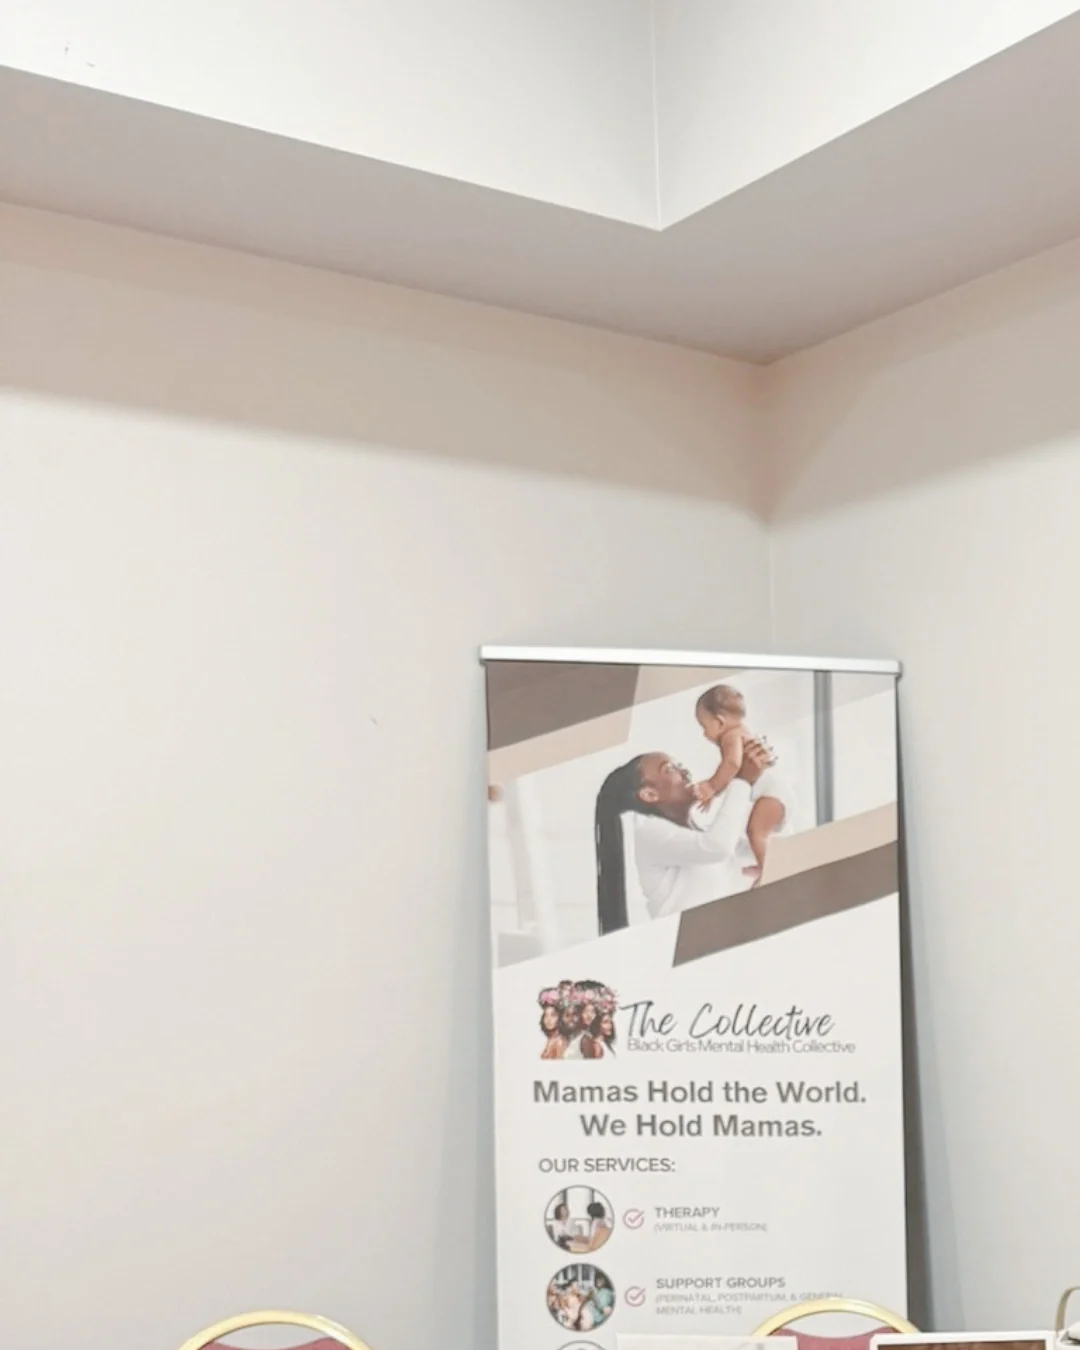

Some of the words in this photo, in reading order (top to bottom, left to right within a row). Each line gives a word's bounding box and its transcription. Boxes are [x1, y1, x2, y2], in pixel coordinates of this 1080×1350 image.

[619, 1000, 676, 1038] The
[689, 1003, 834, 1038] Collective
[627, 1039, 665, 1053] Black
[666, 1039, 697, 1053] Girls
[699, 1039, 745, 1053] Mental
[747, 1040, 791, 1053] Health
[794, 1039, 856, 1053] Collective
[533, 1081, 638, 1103] Mamas
[648, 1081, 714, 1103] Hold
[723, 1081, 767, 1103] the
[776, 1081, 867, 1103] World.
[580, 1115, 627, 1136] We
[637, 1115, 702, 1136] Hold
[713, 1115, 823, 1137] Mamas.
[539, 1158, 580, 1173] OUR
[583, 1157, 676, 1173] SERVICES:
[655, 1206, 720, 1219] THERAPY
[656, 1277, 722, 1289] SUPPORT
[726, 1276, 786, 1289] GROUPS
